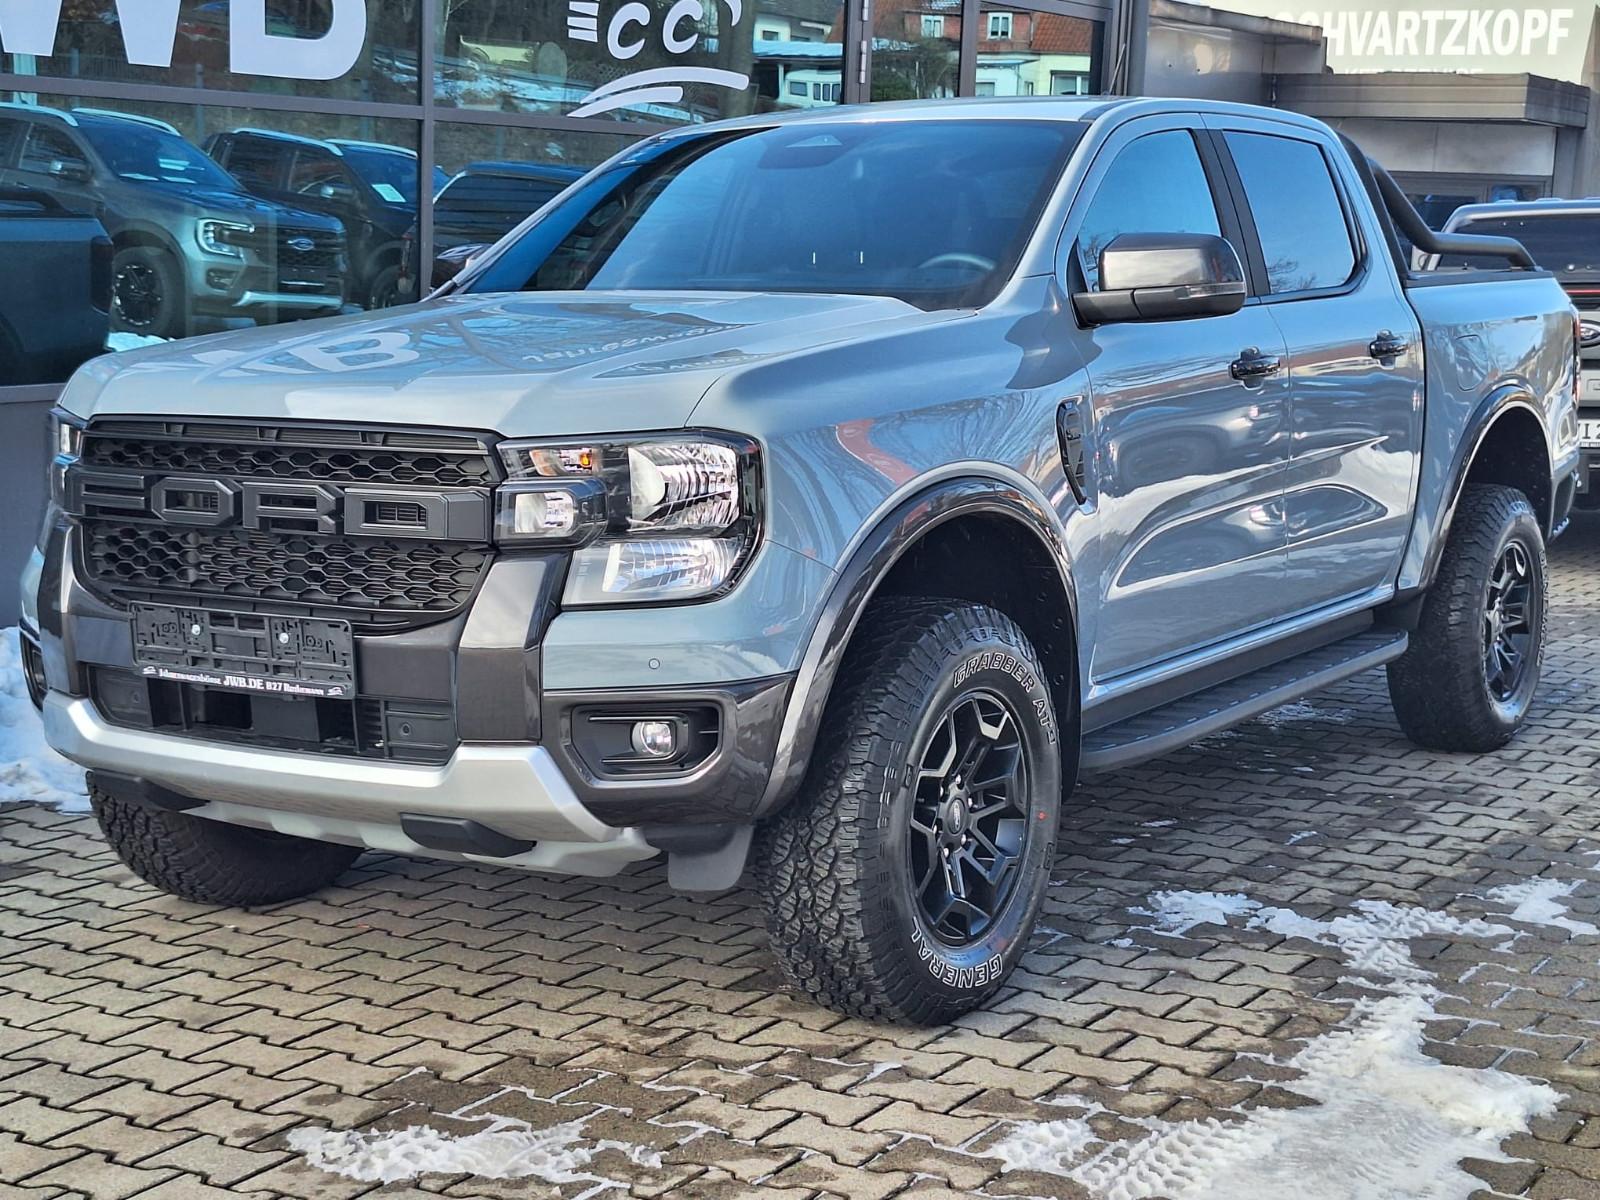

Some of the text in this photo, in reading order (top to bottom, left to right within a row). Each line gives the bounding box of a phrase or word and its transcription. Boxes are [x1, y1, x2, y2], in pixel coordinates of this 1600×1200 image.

[1277, 8, 1575, 57] HVARTZKOPF
[66, 468, 450, 541] FORD
[953, 652, 1035, 693] GRABBER
[911, 915, 1003, 989] GENERAL
